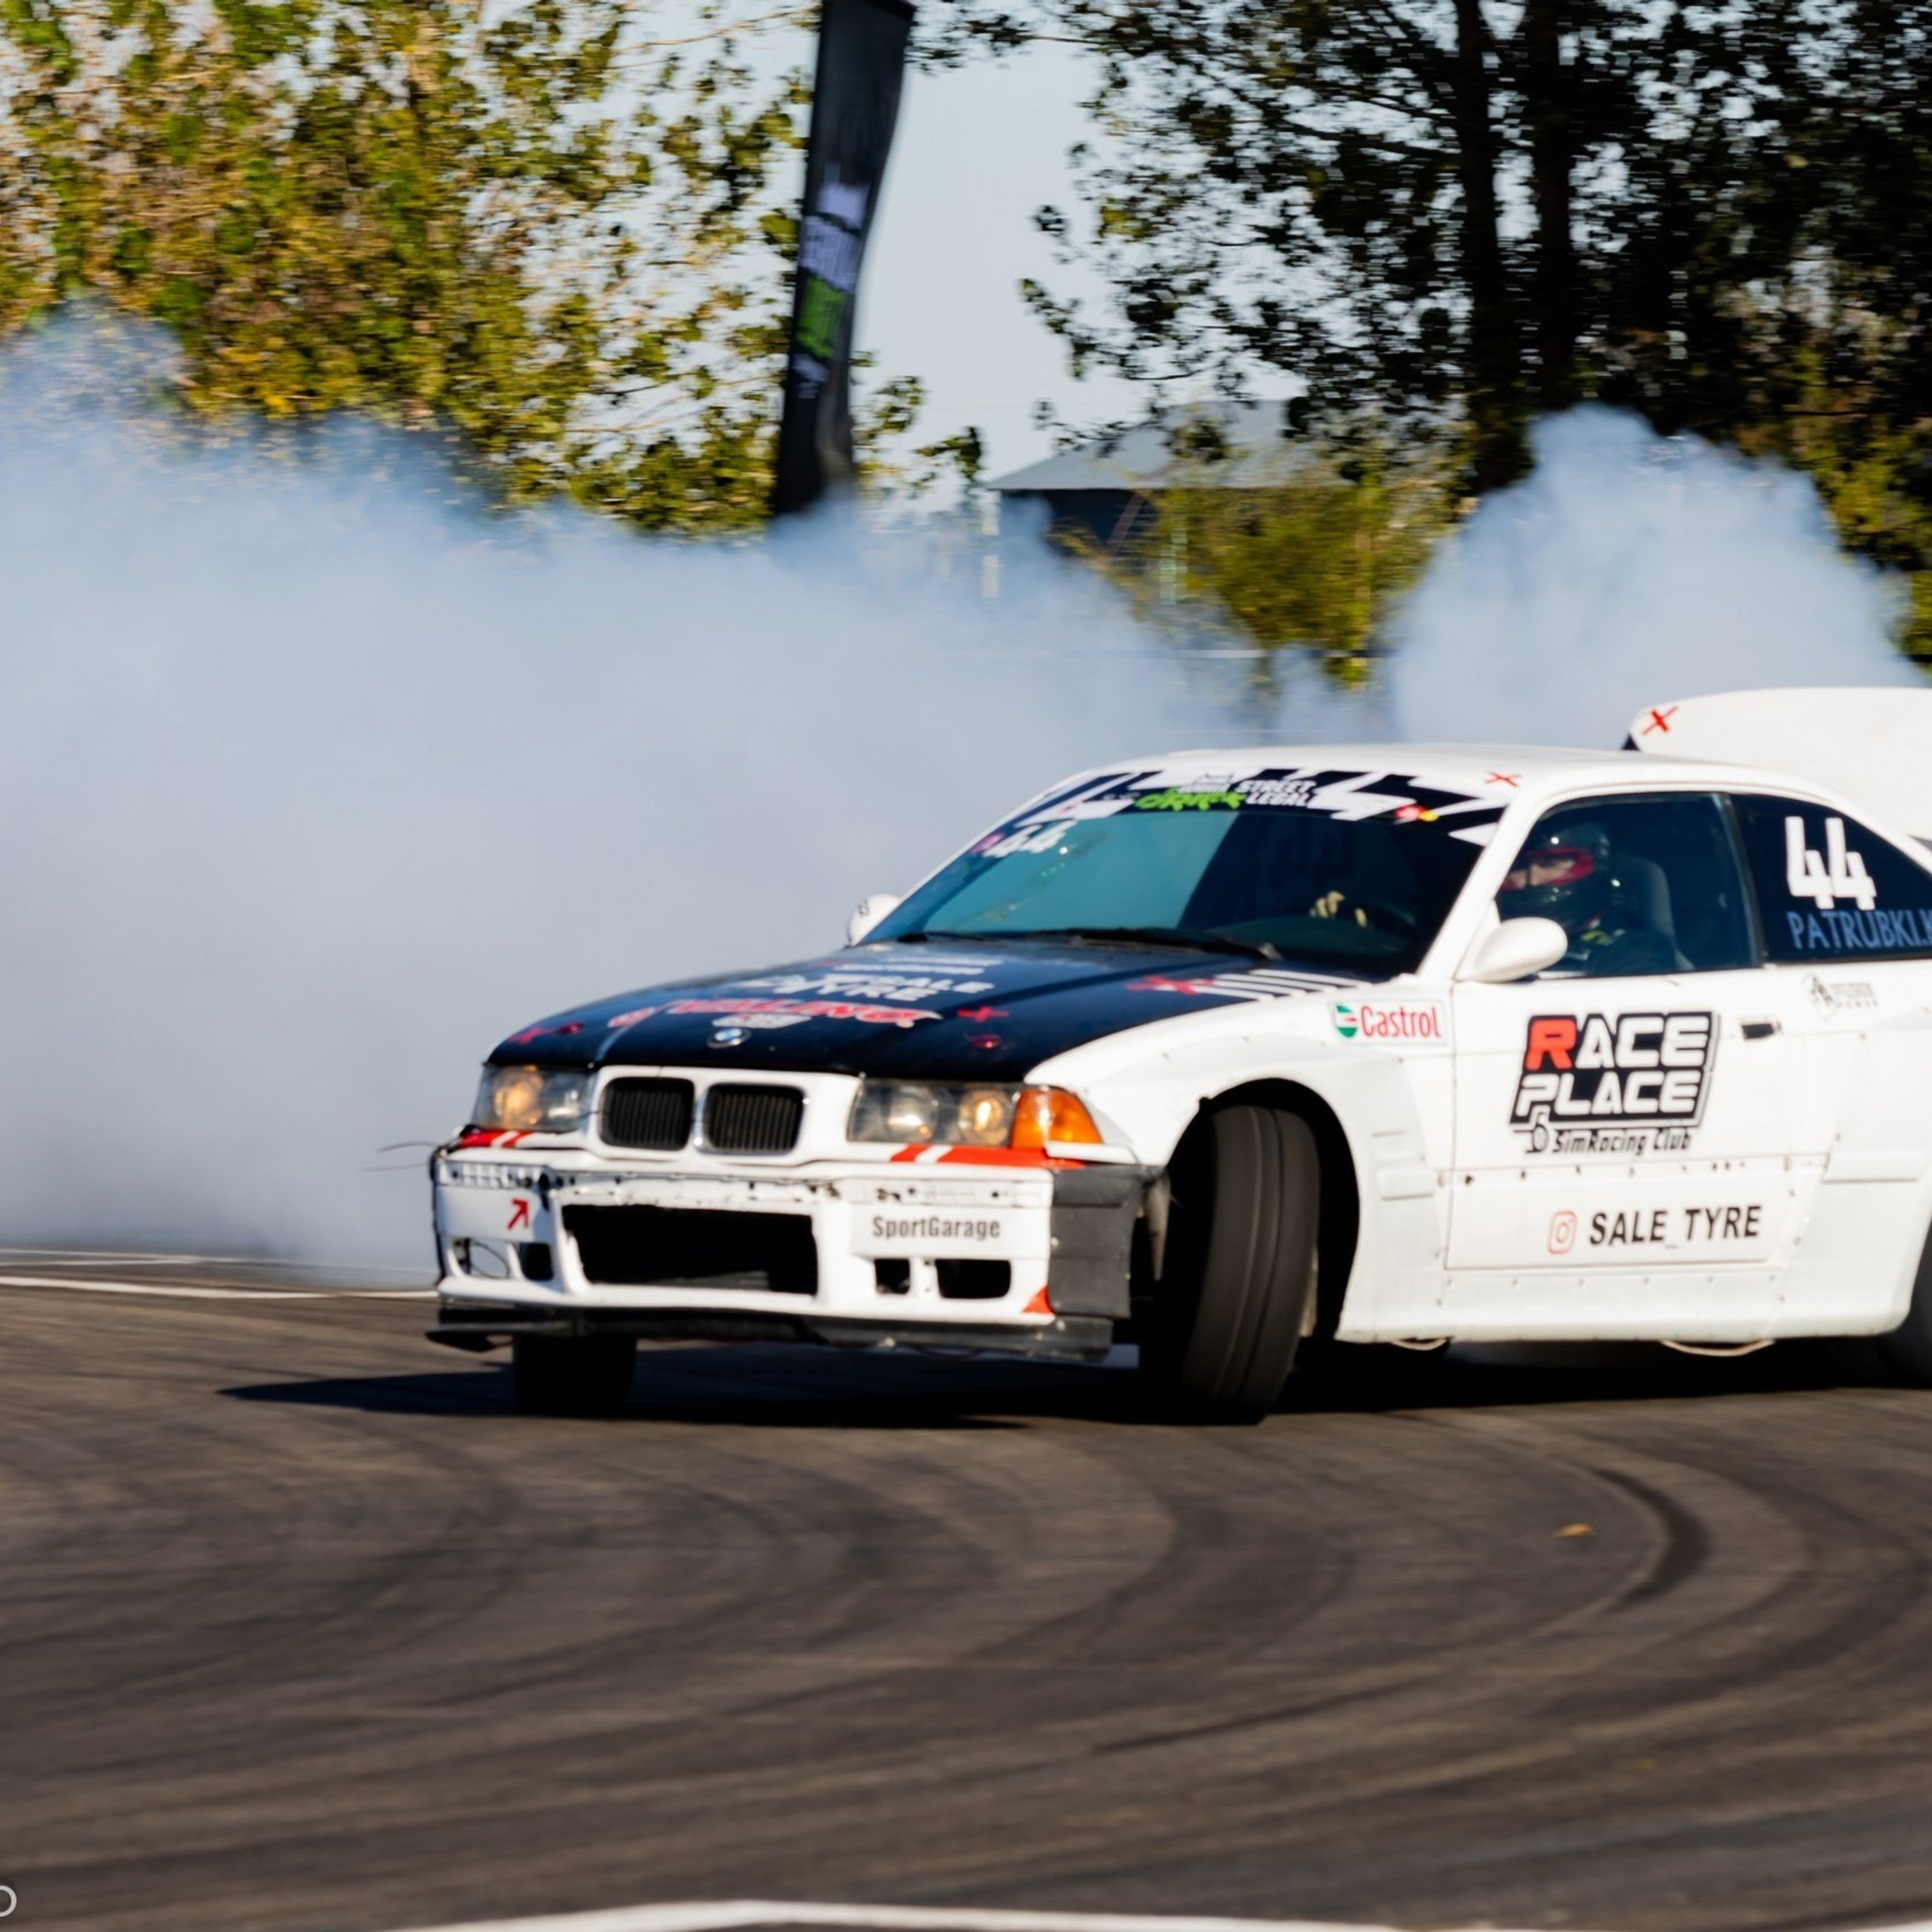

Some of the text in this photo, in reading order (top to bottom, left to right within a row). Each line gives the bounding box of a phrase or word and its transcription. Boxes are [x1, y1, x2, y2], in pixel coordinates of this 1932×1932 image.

[1235, 780, 1317, 793] STREET
[1245, 792, 1313, 807] LEGAL
[1785, 816, 1877, 910] 44
[1360, 1005, 1441, 1038] Castrol
[1523, 1015, 1711, 1070] RACE
[1514, 1069, 1703, 1117] PLACE
[1552, 1130, 1691, 1155] SimRacing Club
[872, 1216, 1001, 1241] SportGarage
